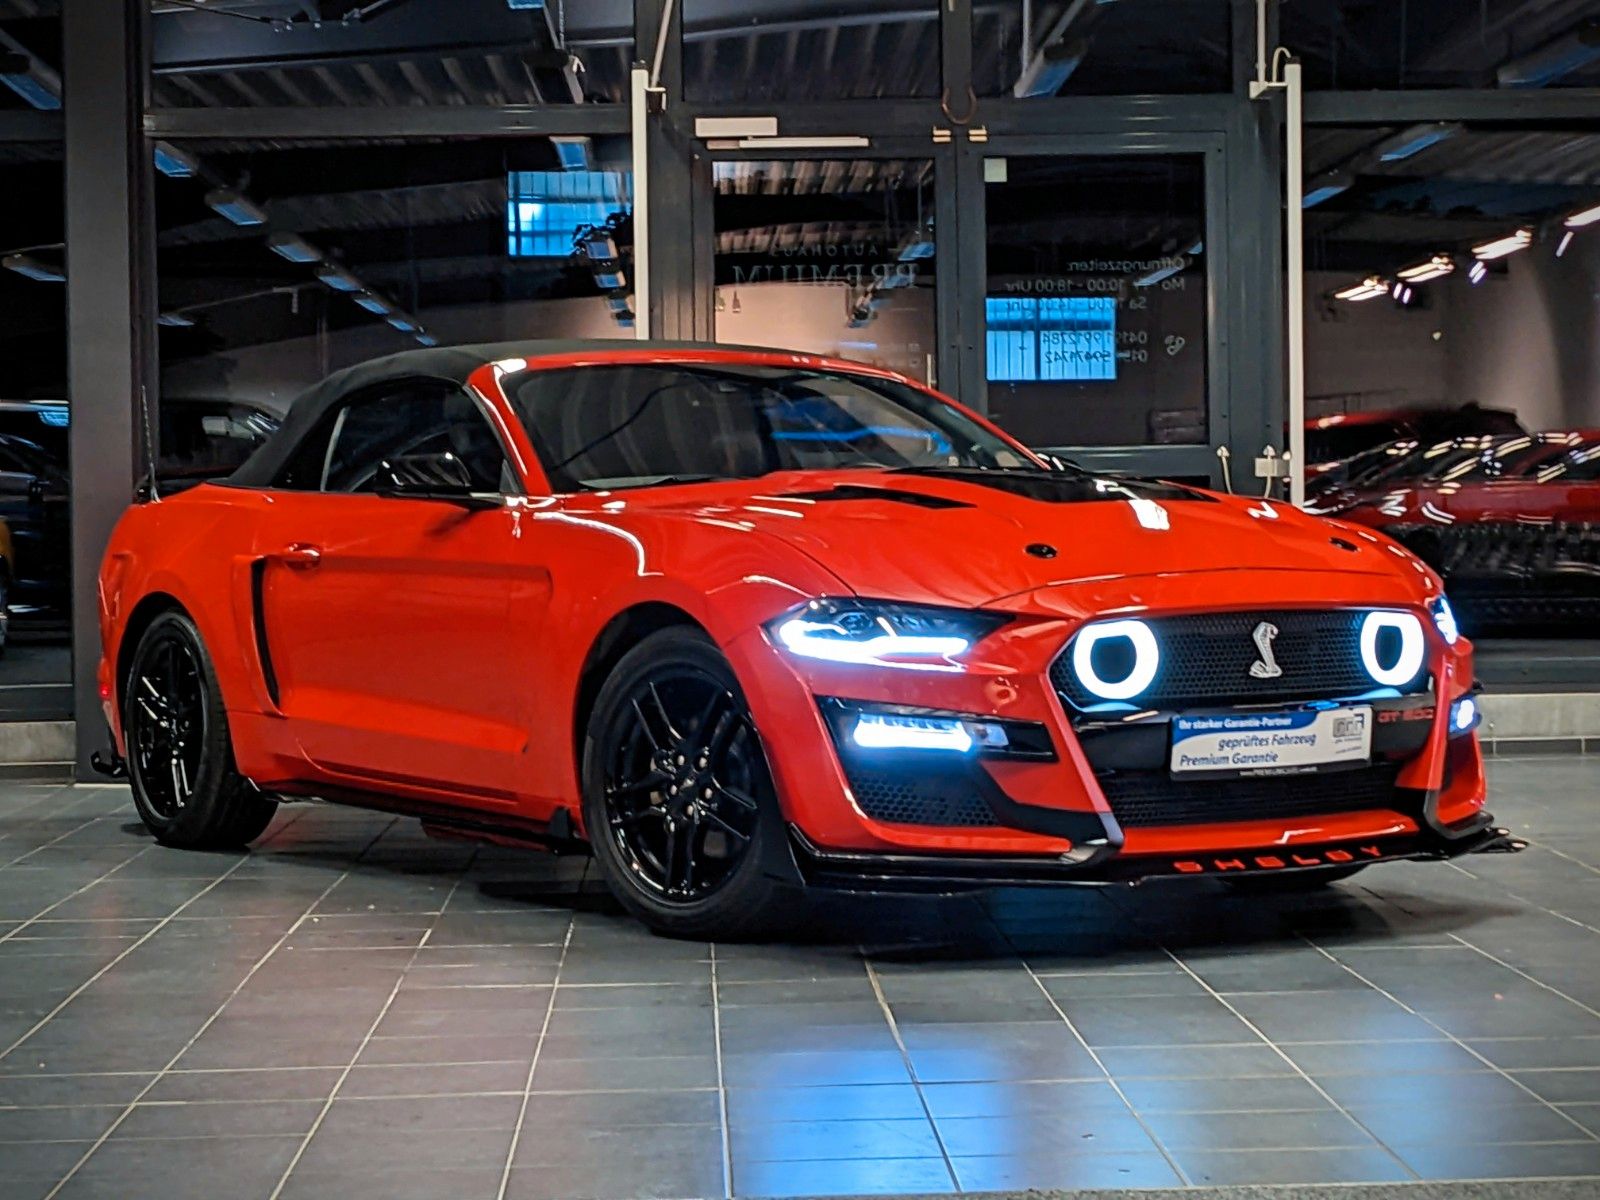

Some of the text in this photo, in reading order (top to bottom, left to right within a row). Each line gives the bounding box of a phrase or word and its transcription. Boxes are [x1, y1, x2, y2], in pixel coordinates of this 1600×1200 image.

[1218, 735, 1270, 751] geprüftes
[1271, 733, 1317, 747] Fahrzeug
[1180, 752, 1279, 766] Premium Garantie
